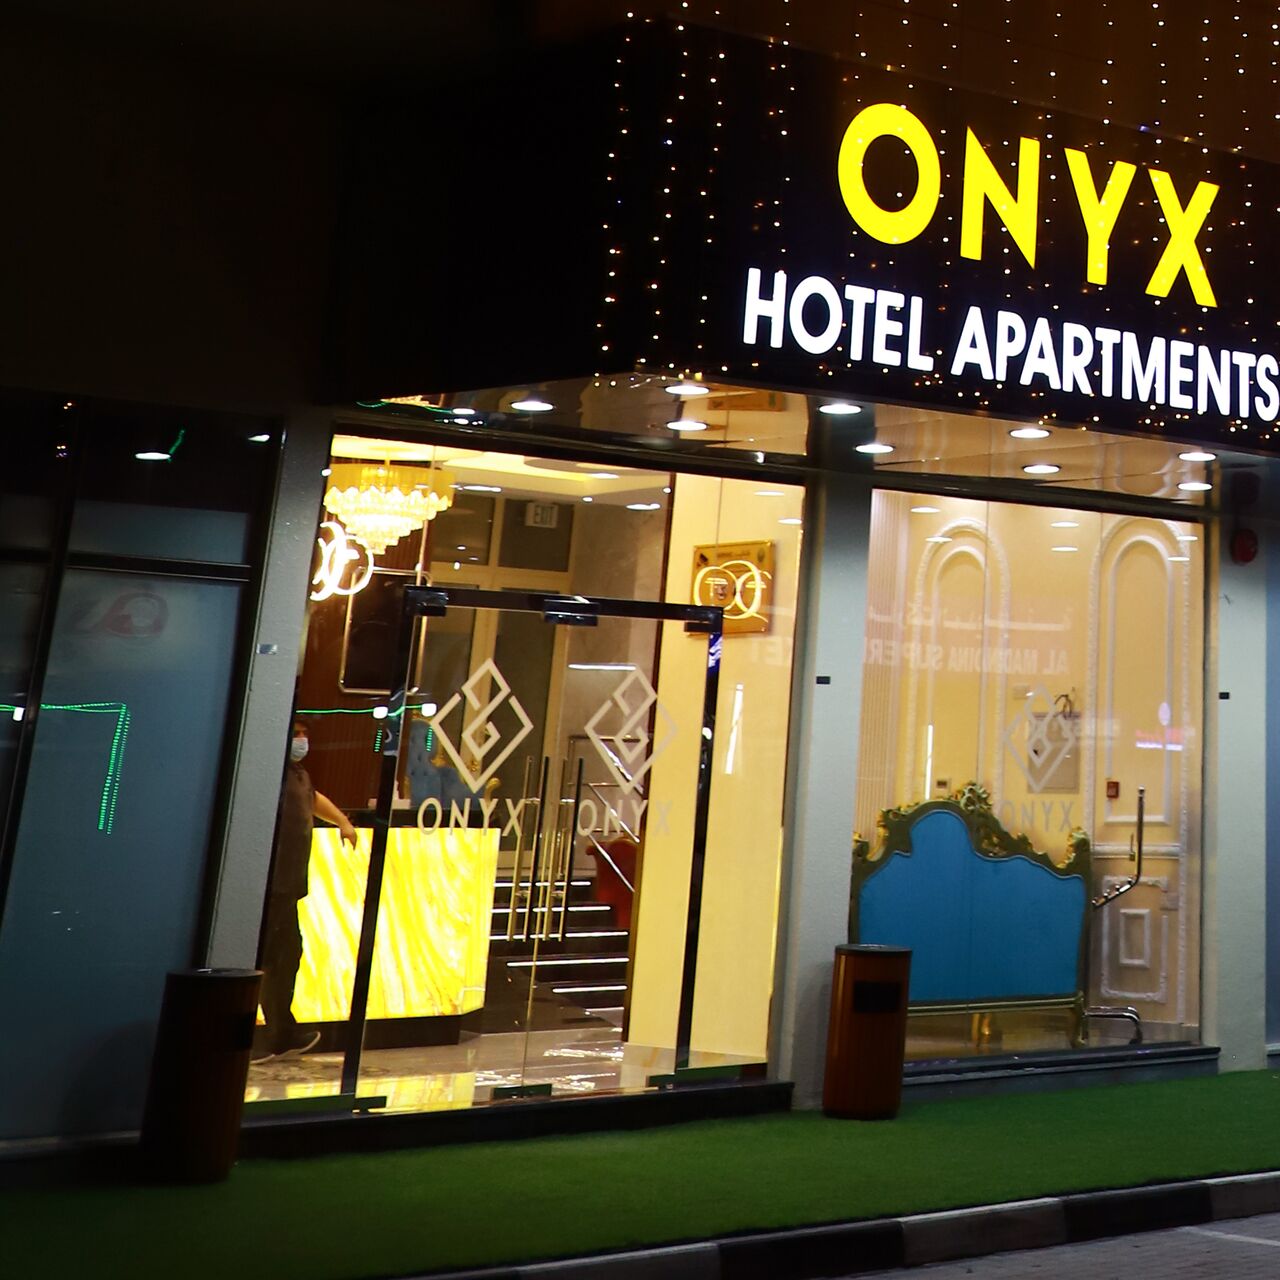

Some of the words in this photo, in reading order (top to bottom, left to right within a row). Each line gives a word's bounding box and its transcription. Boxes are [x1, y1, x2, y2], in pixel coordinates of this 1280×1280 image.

[837, 102, 1220, 308] ONYX
[742, 267, 934, 372] HOTEL
[951, 305, 1280, 422] APARTMENTS
[417, 797, 525, 837] ONYX
[576, 798, 673, 836] ONYX
[1000, 799, 1074, 833] ONYX
